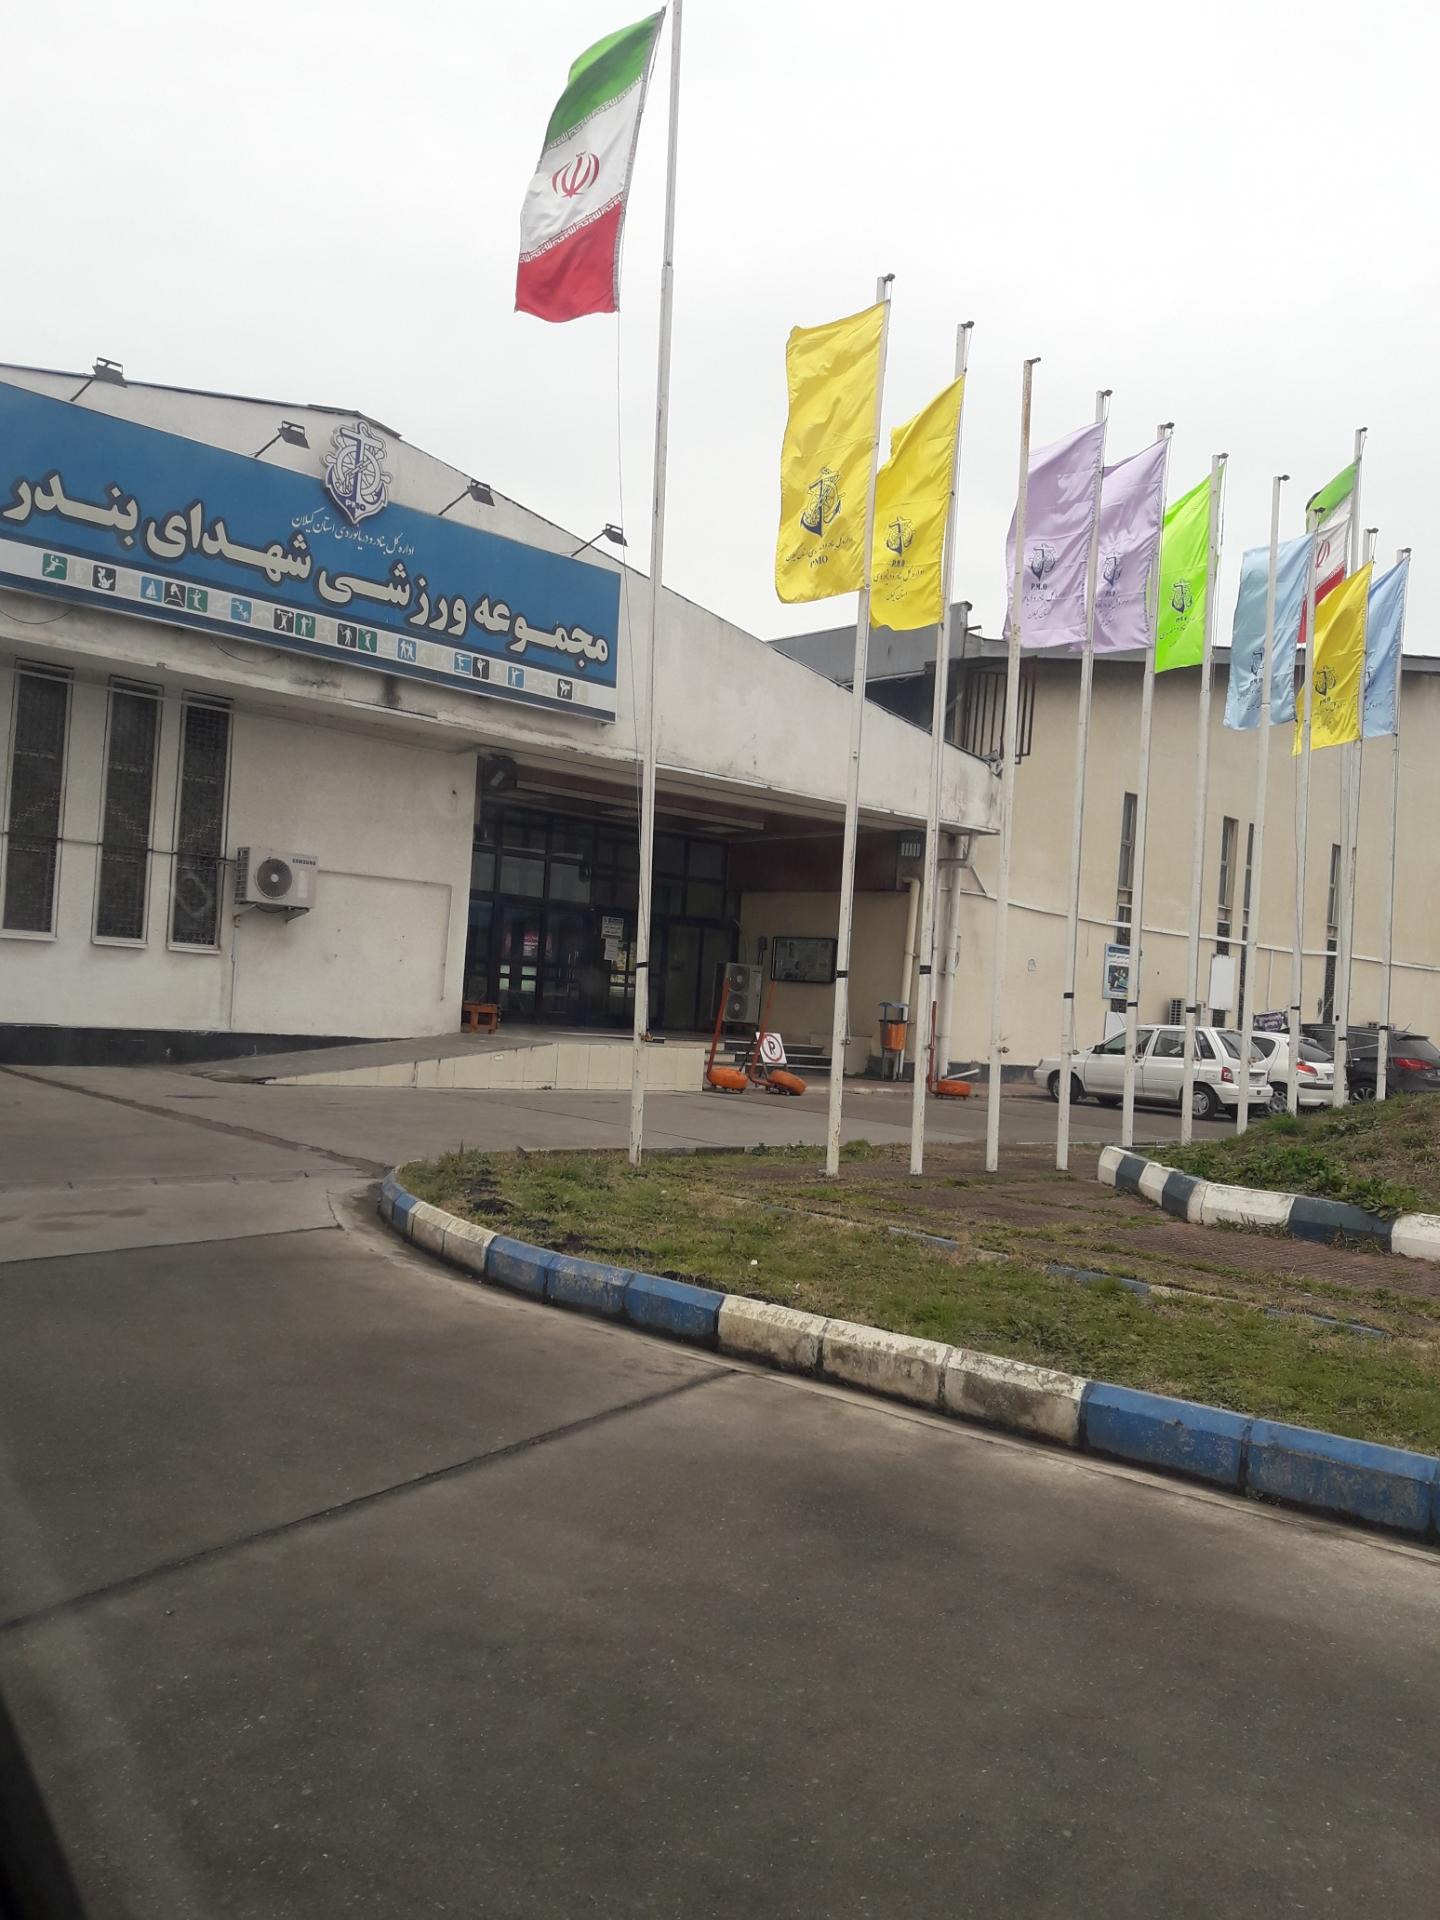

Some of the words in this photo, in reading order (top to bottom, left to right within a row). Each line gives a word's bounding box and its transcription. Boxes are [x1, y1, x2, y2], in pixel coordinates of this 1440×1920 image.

[3, 473, 139, 549] بندر
[146, 502, 312, 584] شهدای
[317, 562, 467, 637] ورزشی
[474, 596, 609, 668] مجموعه
